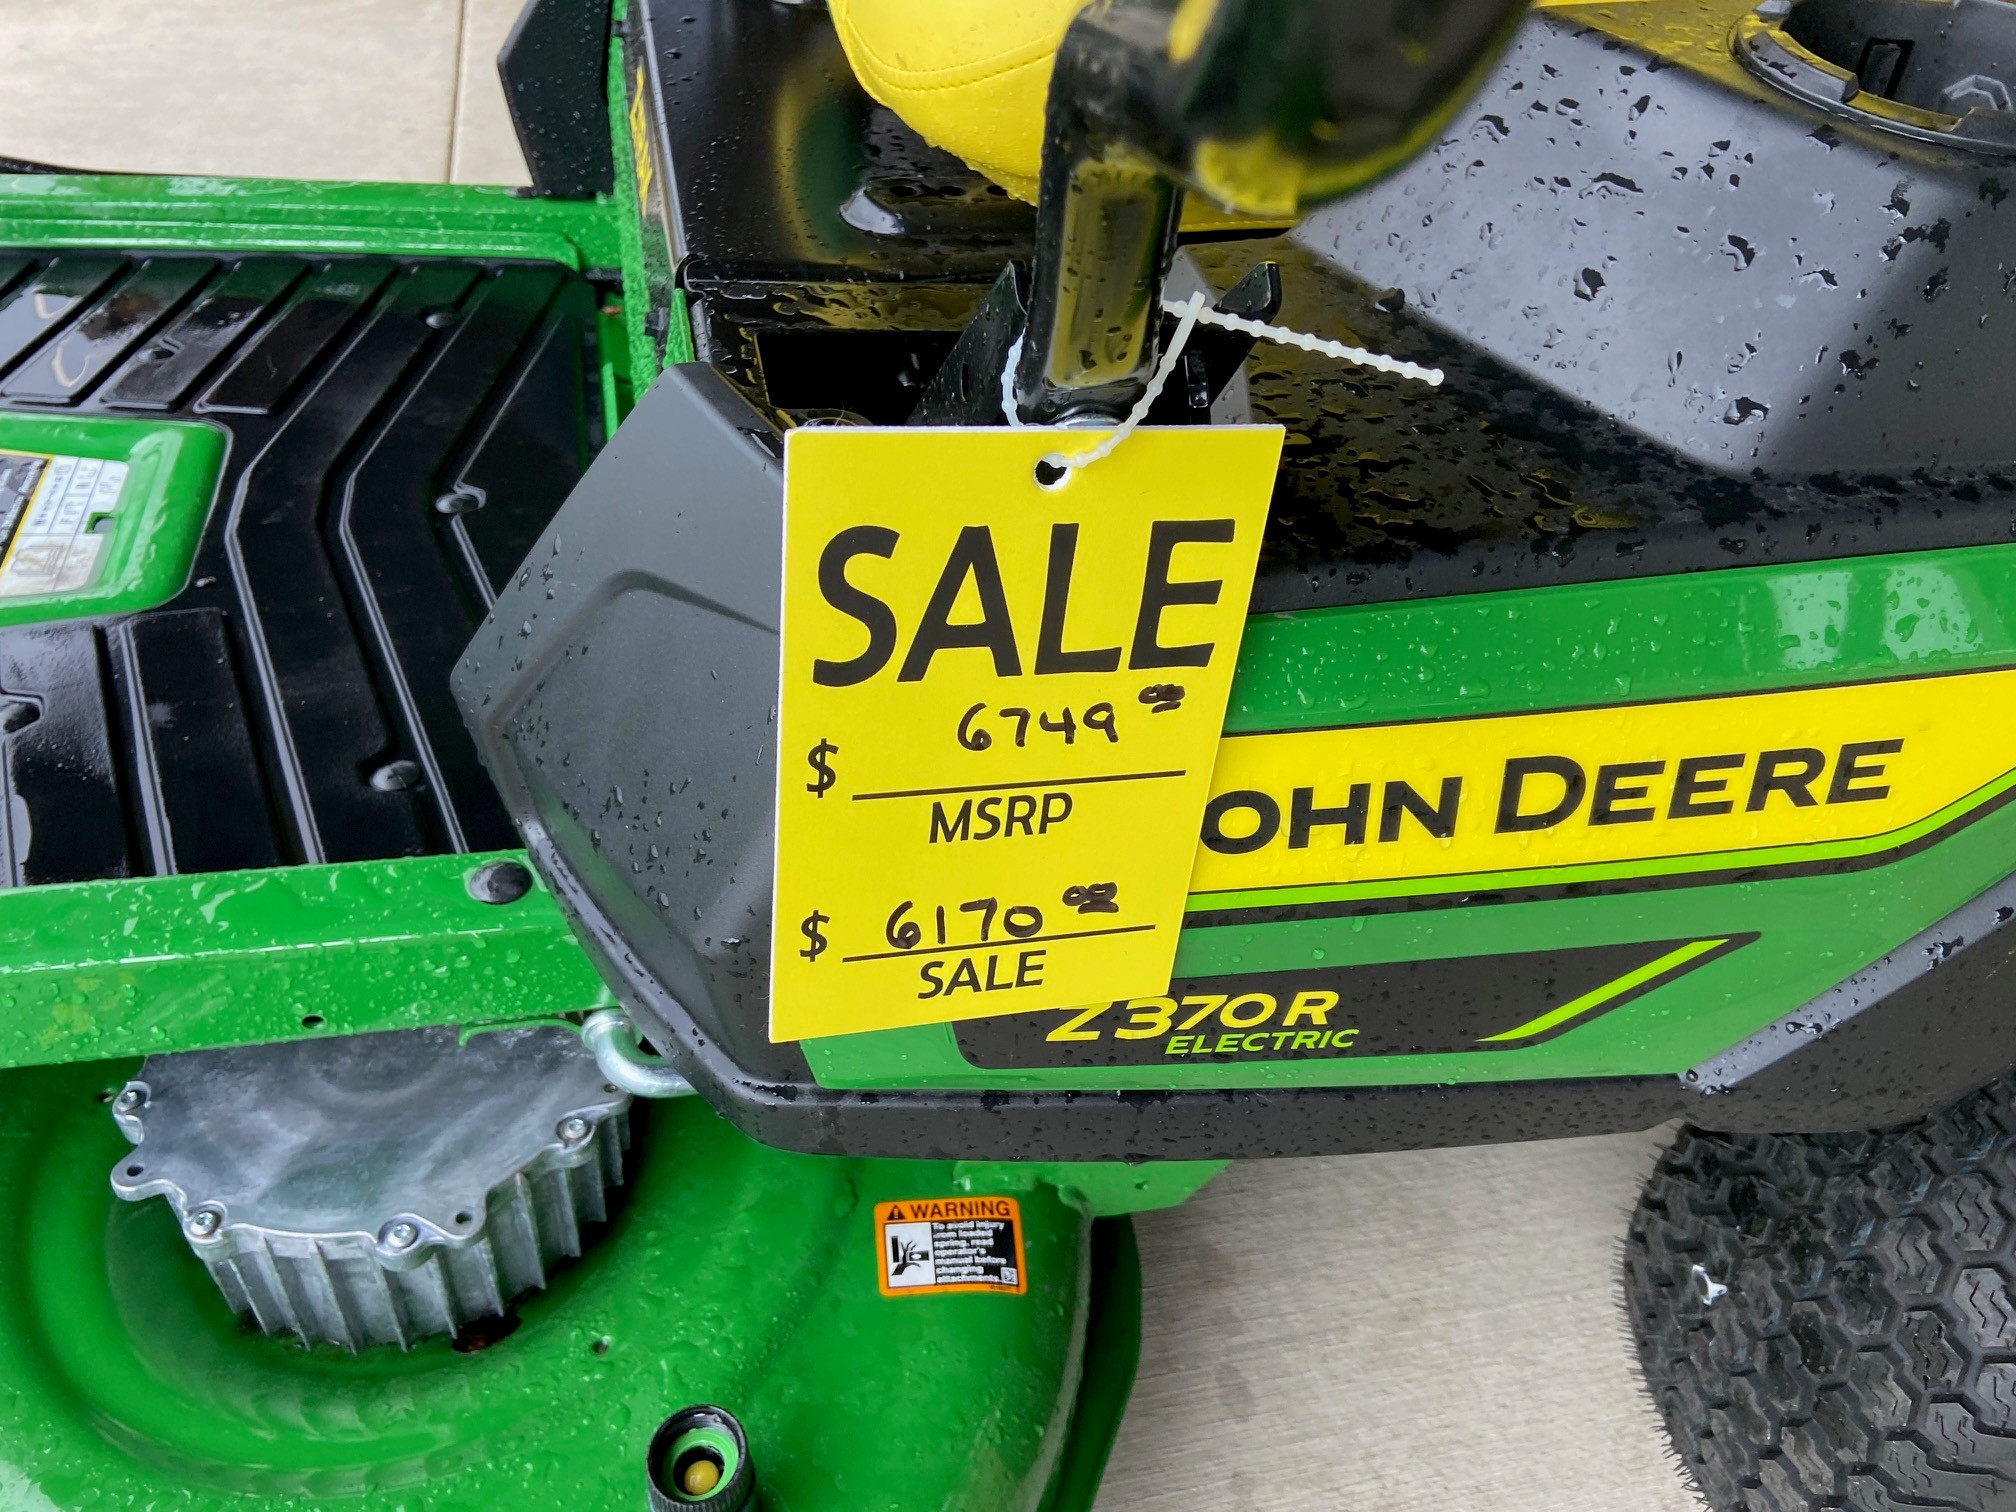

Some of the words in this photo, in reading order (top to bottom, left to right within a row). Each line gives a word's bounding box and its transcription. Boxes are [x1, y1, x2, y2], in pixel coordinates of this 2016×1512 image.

[813, 519, 1235, 687] SALE
[806, 738, 839, 799] $
[957, 702, 1119, 752] 6749
[929, 792, 1073, 844] MSRP
[1199, 776, 1463, 856] OHN
[1494, 738, 1906, 836] DEERE
[799, 910, 830, 962] $
[885, 897, 1043, 950] 6170
[917, 949, 1047, 1000] SALE
[1164, 1028, 1360, 1055] ELECTRIC
[910, 1200, 1010, 1219] WARNING
